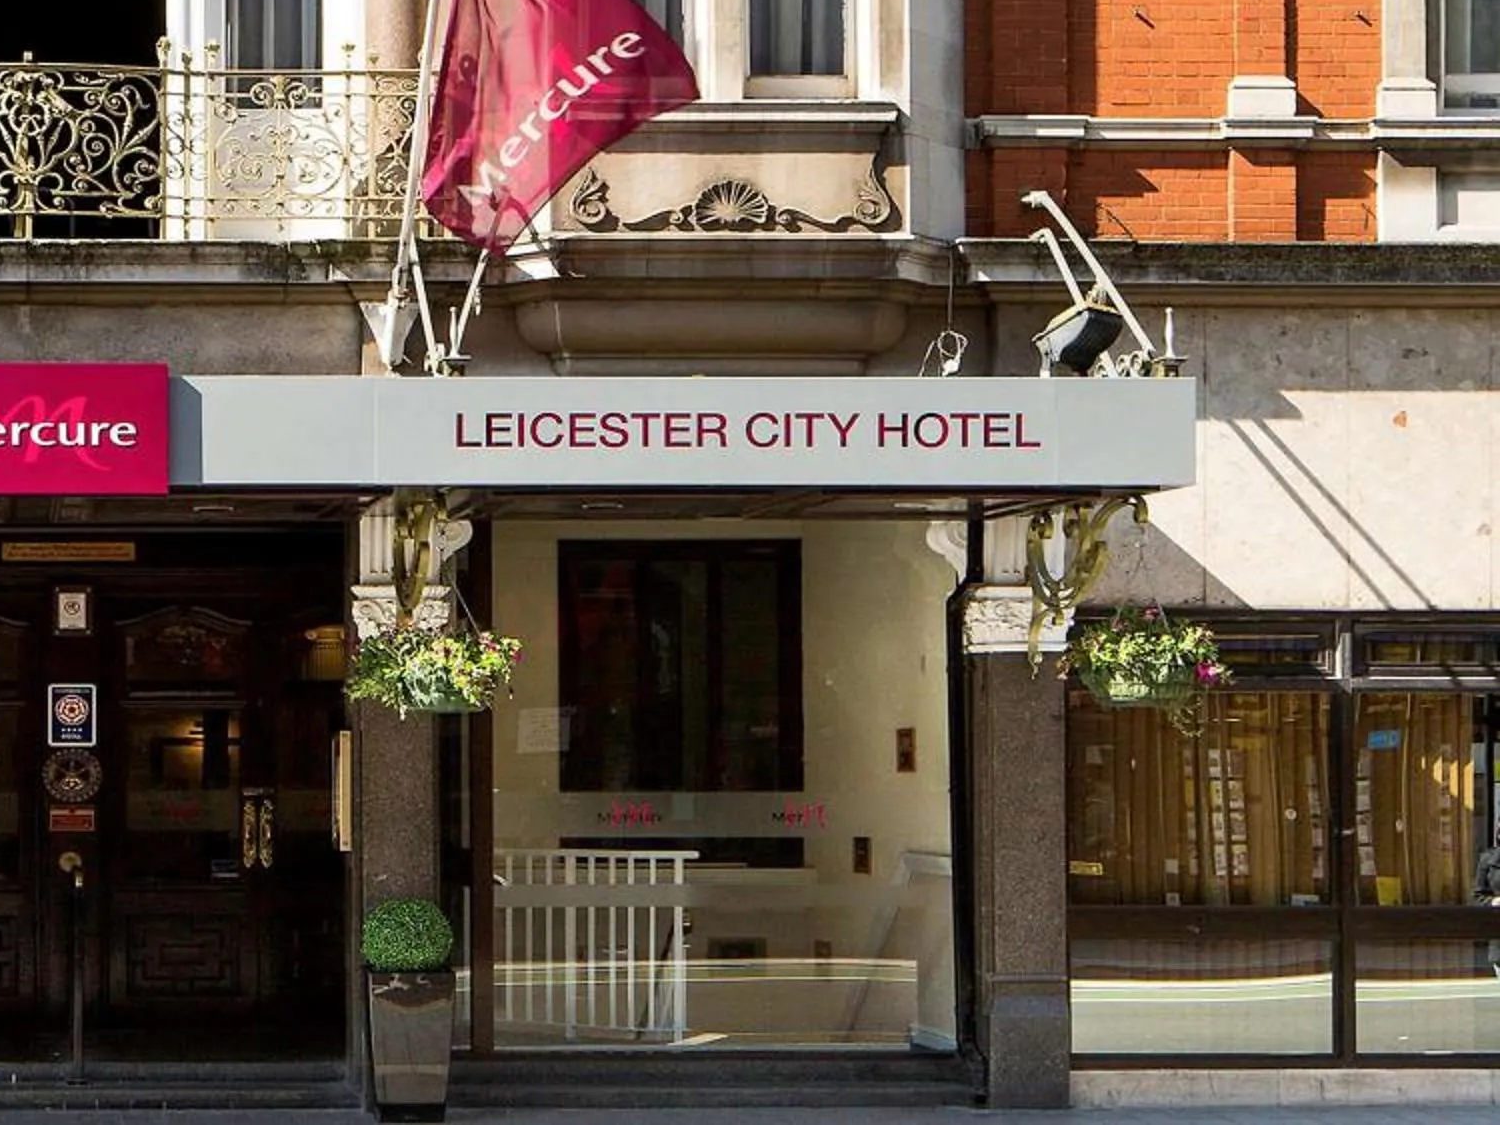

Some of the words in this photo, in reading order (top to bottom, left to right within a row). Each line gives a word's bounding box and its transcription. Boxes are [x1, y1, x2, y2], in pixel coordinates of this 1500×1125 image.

[457, 31, 646, 206] Mercure
[454, 411, 727, 448] LEICESTER
[744, 411, 860, 448] CITY
[876, 411, 1041, 448] HOTEL
